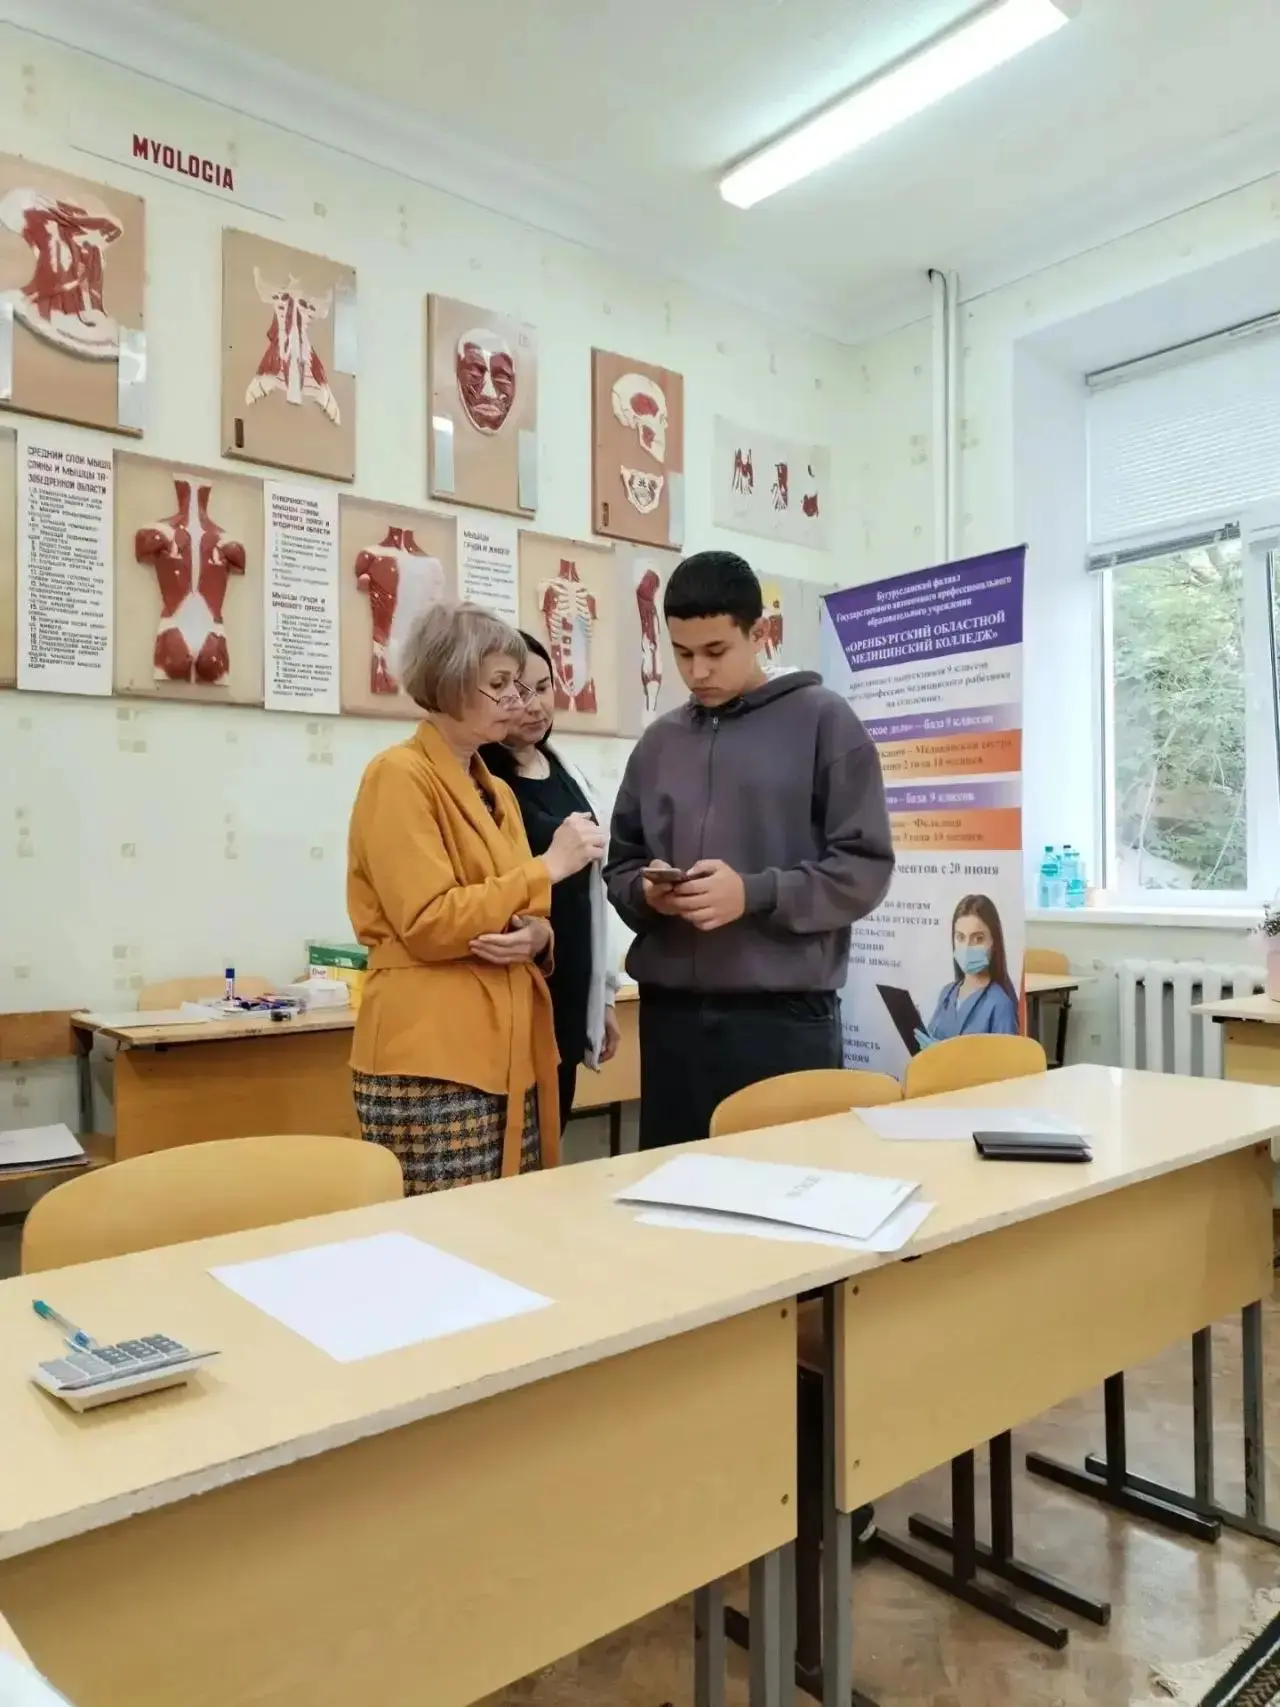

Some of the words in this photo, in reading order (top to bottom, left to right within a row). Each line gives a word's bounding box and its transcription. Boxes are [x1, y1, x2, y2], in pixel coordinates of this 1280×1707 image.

[132, 133, 234, 191] MYOLOGIA
[55, 466, 60, 474] И
[836, 603, 891, 622] Государственного
[937, 576, 1013, 600] профессионального
[876, 580, 932, 602] Бугурусланский
[932, 574, 961, 589] филиал
[867, 608, 926, 628] образовательного
[927, 598, 972, 616] учреждения
[846, 625, 931, 652] «ОРЕНБУРГСКИЙ
[933, 609, 1005, 635] ОБЛАСТНОЙ
[851, 639, 933, 664] МЕДИЦИНСКИЙ
[935, 629, 999, 650] КОЛЛЕДЖ»
[948, 862, 960, 875] 20
[964, 865, 999, 876] июня
